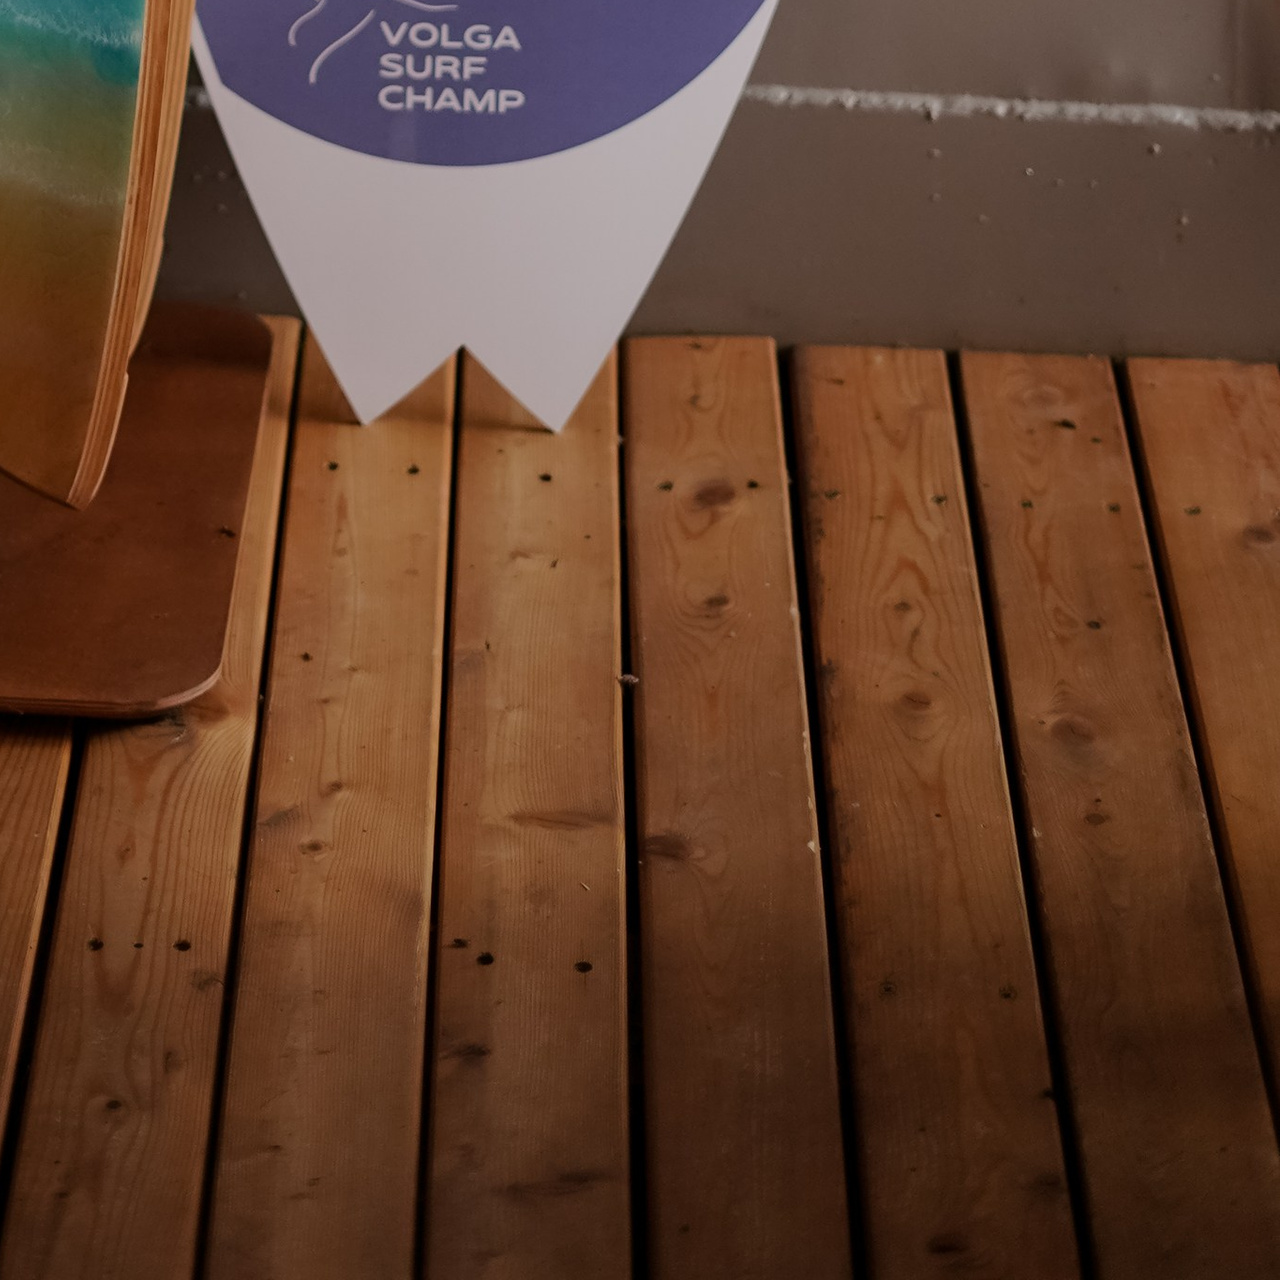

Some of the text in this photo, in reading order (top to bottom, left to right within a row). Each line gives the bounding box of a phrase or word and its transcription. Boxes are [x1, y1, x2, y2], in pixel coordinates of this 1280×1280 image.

[380, 20, 522, 52] VOLGA
[379, 53, 488, 81] SURF
[377, 84, 526, 115] CHAMP
